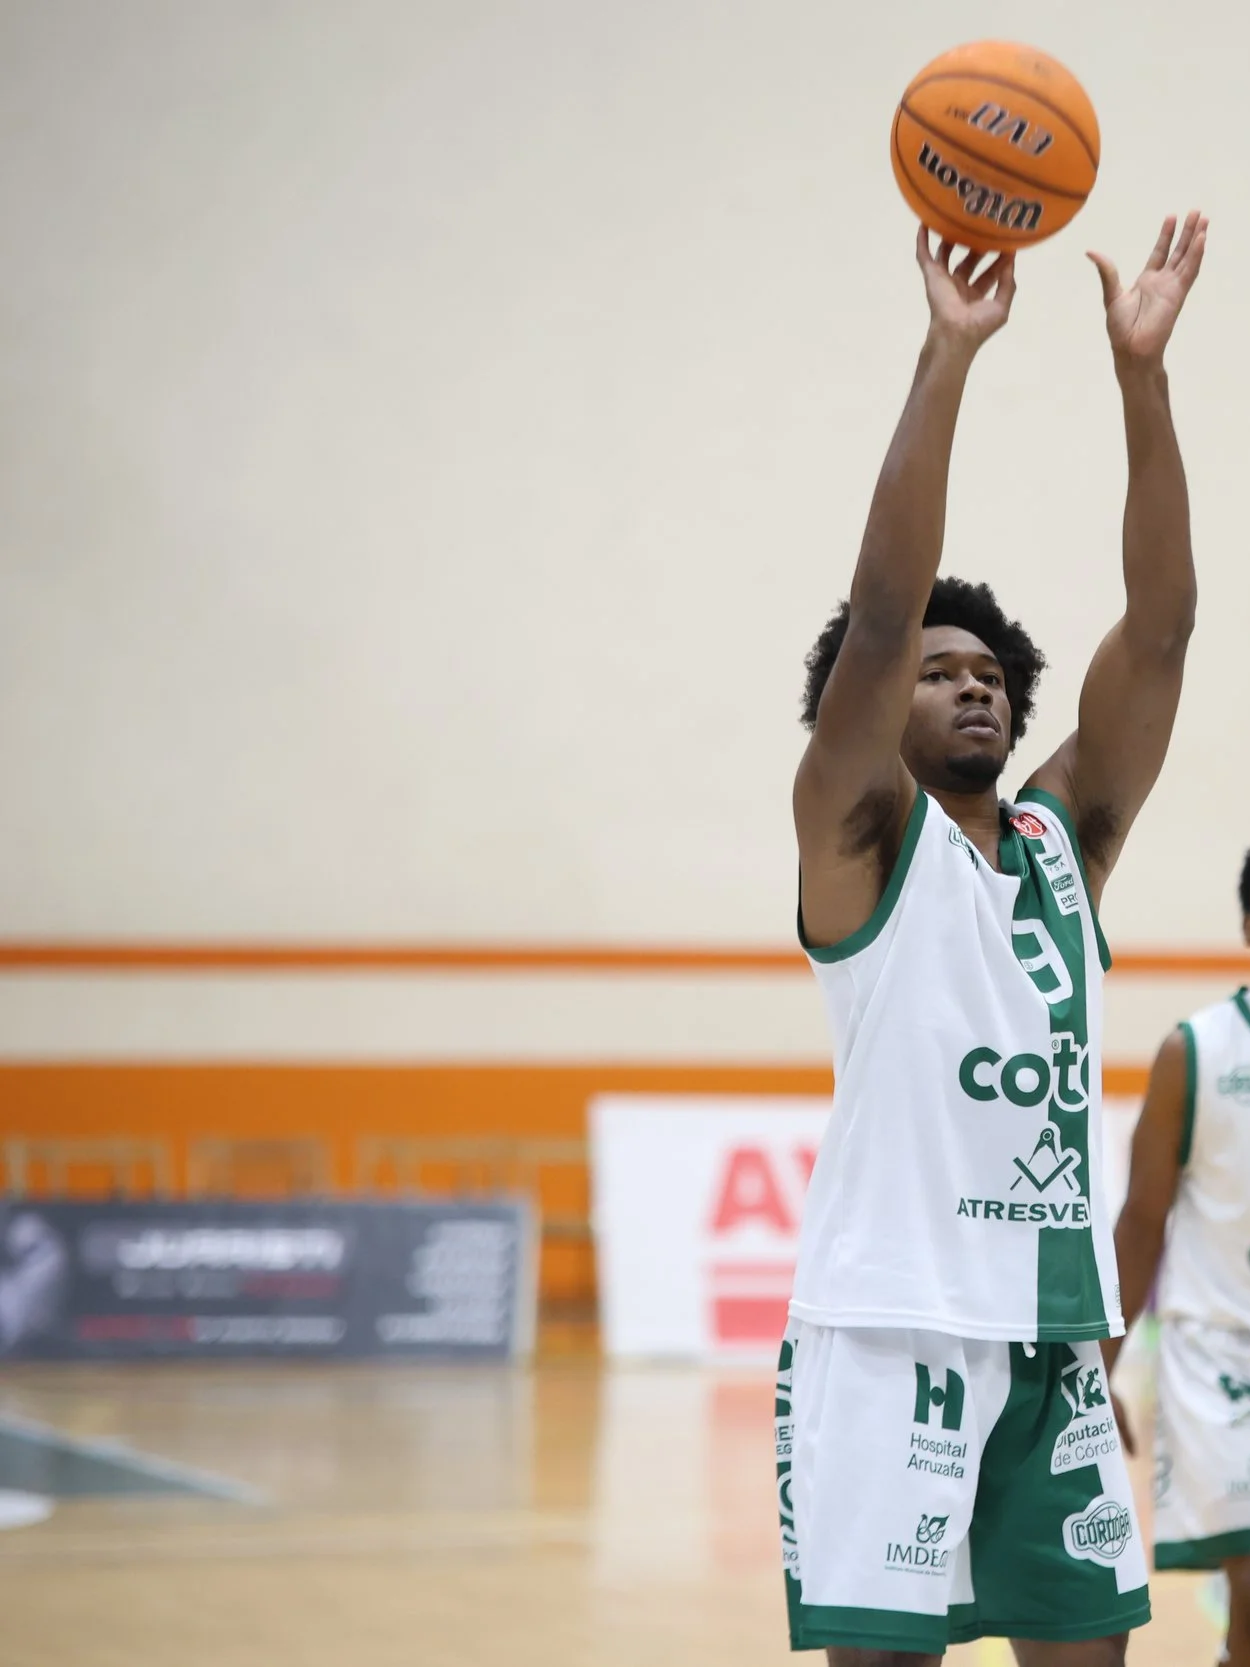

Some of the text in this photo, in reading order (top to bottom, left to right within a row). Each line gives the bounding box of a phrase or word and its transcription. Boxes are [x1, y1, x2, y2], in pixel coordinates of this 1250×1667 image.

[968, 101, 1054, 156] EVO
[917, 139, 1043, 232] Wilson
[1053, 876, 1074, 891] Ford
[959, 1038, 1089, 1107] cot
[910, 1432, 967, 1458] Hospital
[907, 1453, 965, 1479] Arruzafa
[1054, 1452, 1071, 1468] de
